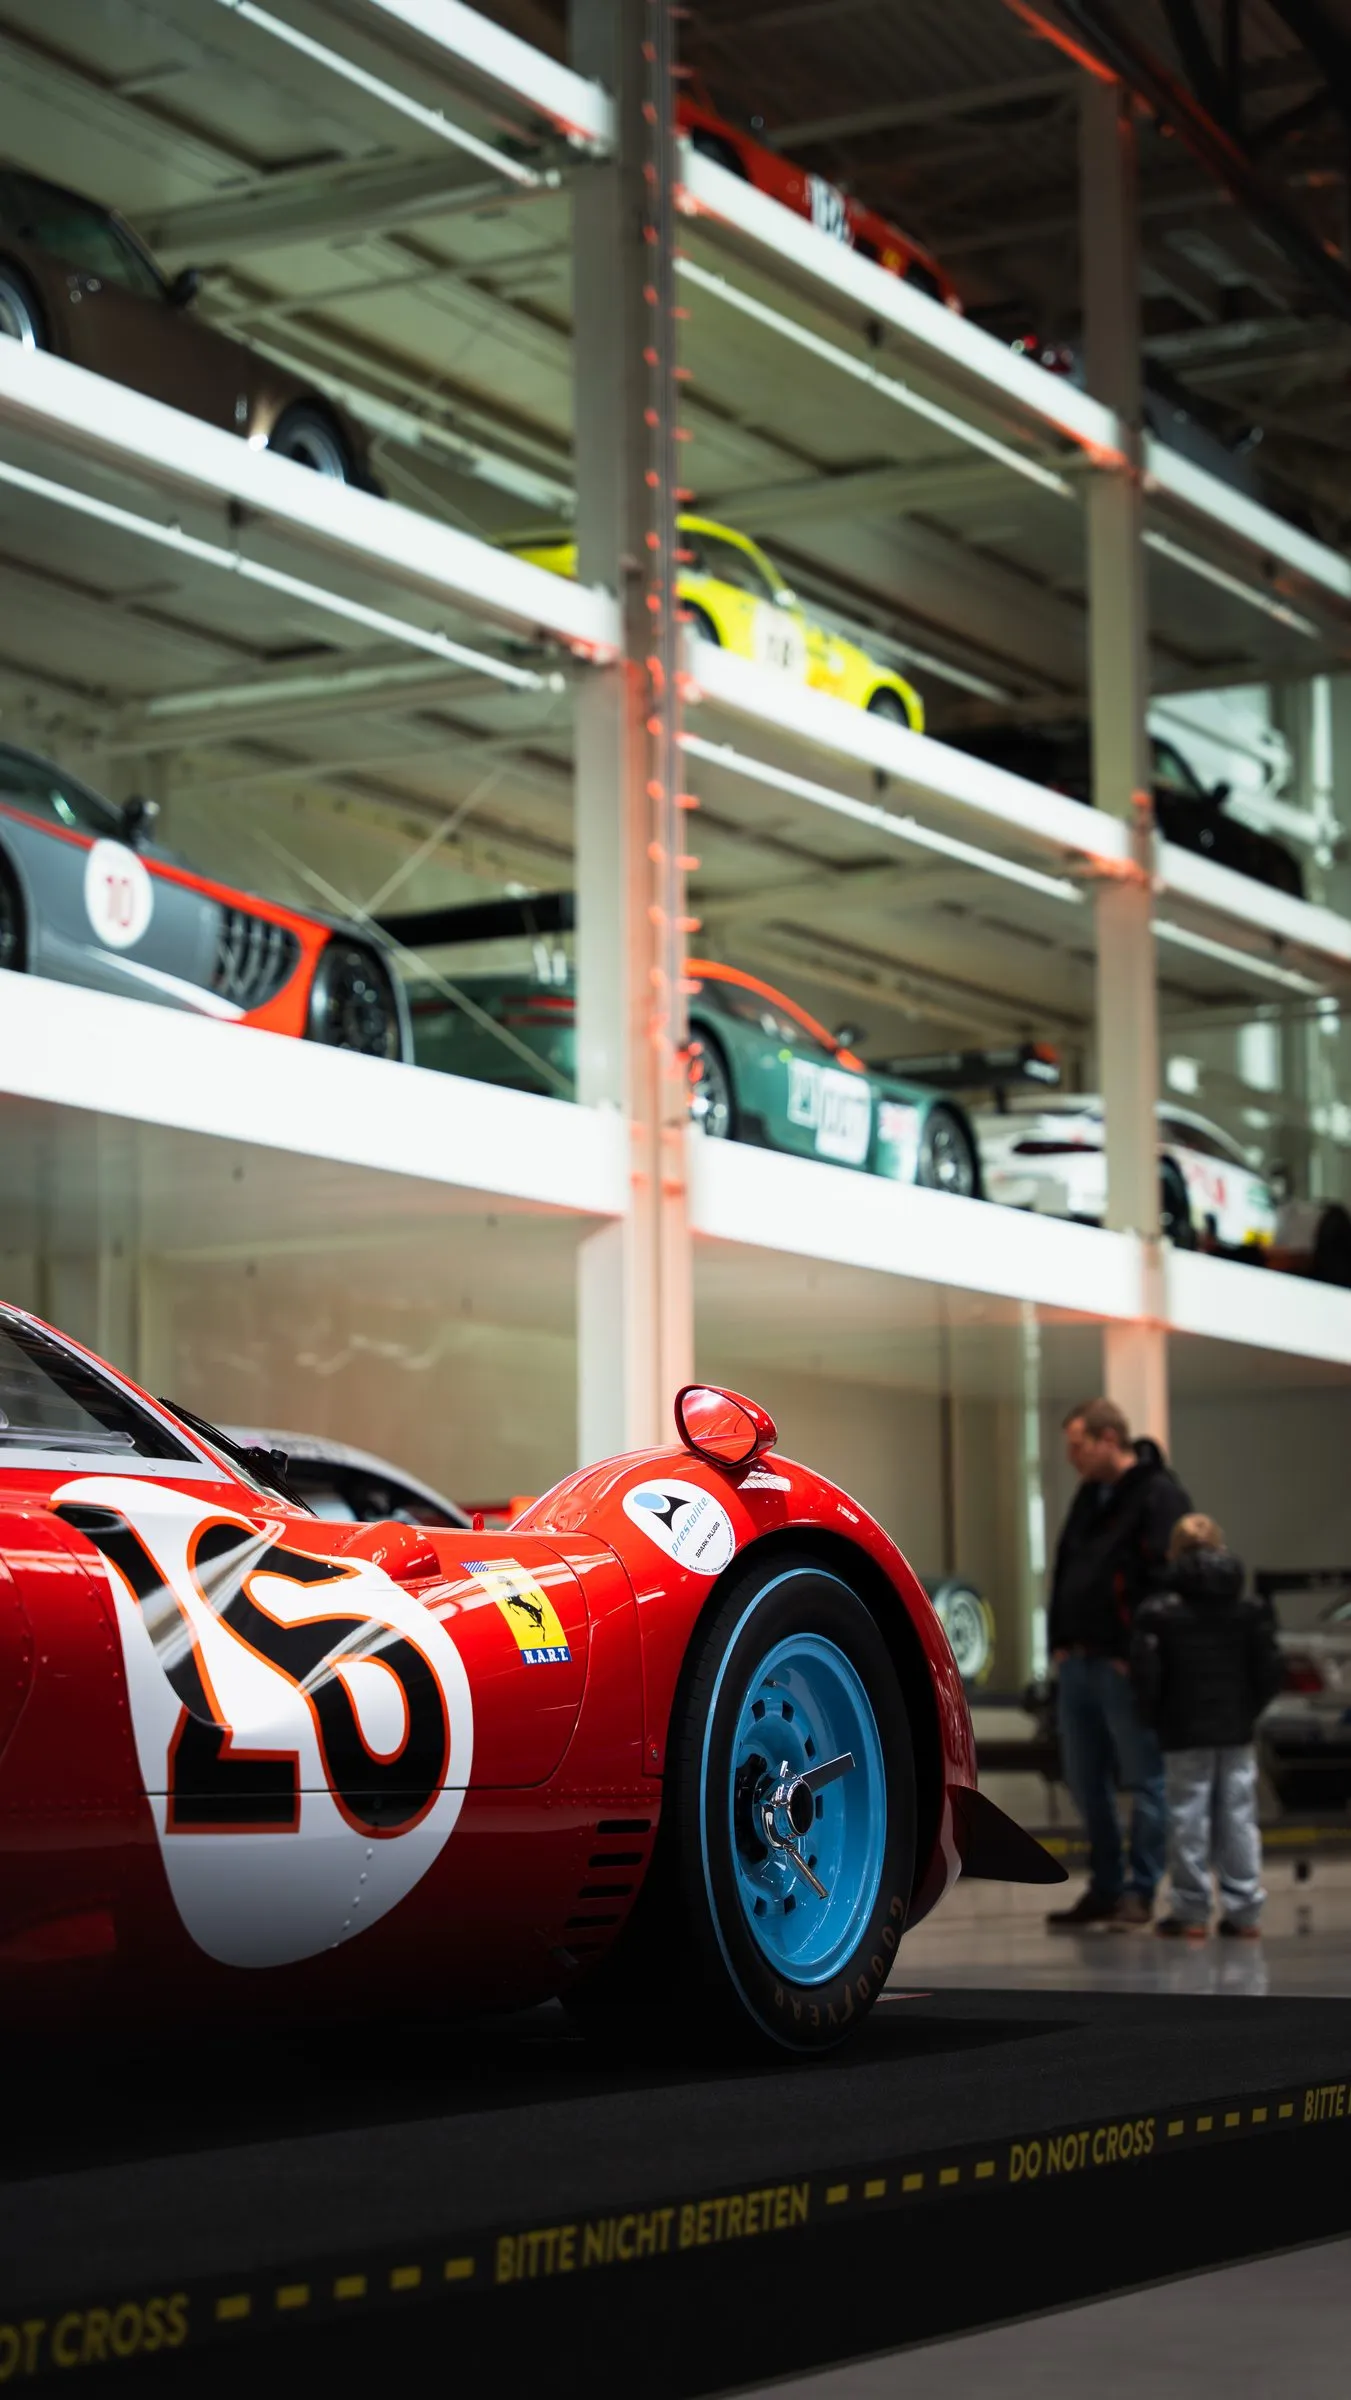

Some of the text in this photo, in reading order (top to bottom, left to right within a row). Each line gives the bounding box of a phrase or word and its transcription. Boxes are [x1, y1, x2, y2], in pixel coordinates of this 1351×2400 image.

[671, 1495, 709, 1556] prestolite
[695, 1538, 709, 1559] SPARK
[706, 1521, 720, 1541] PLUGS
[48, 1499, 451, 1840] 26
[523, 1647, 569, 1664] N.A.R.T.
[774, 1895, 904, 2027] GOODYEAR
[1303, 2083, 1345, 2122] BITTE
[1008, 2117, 1155, 2183] DO NOT CROSS
[494, 2181, 810, 2286] BITTE NICHT BETRETEN
[51, 2291, 191, 2368] CROSS
